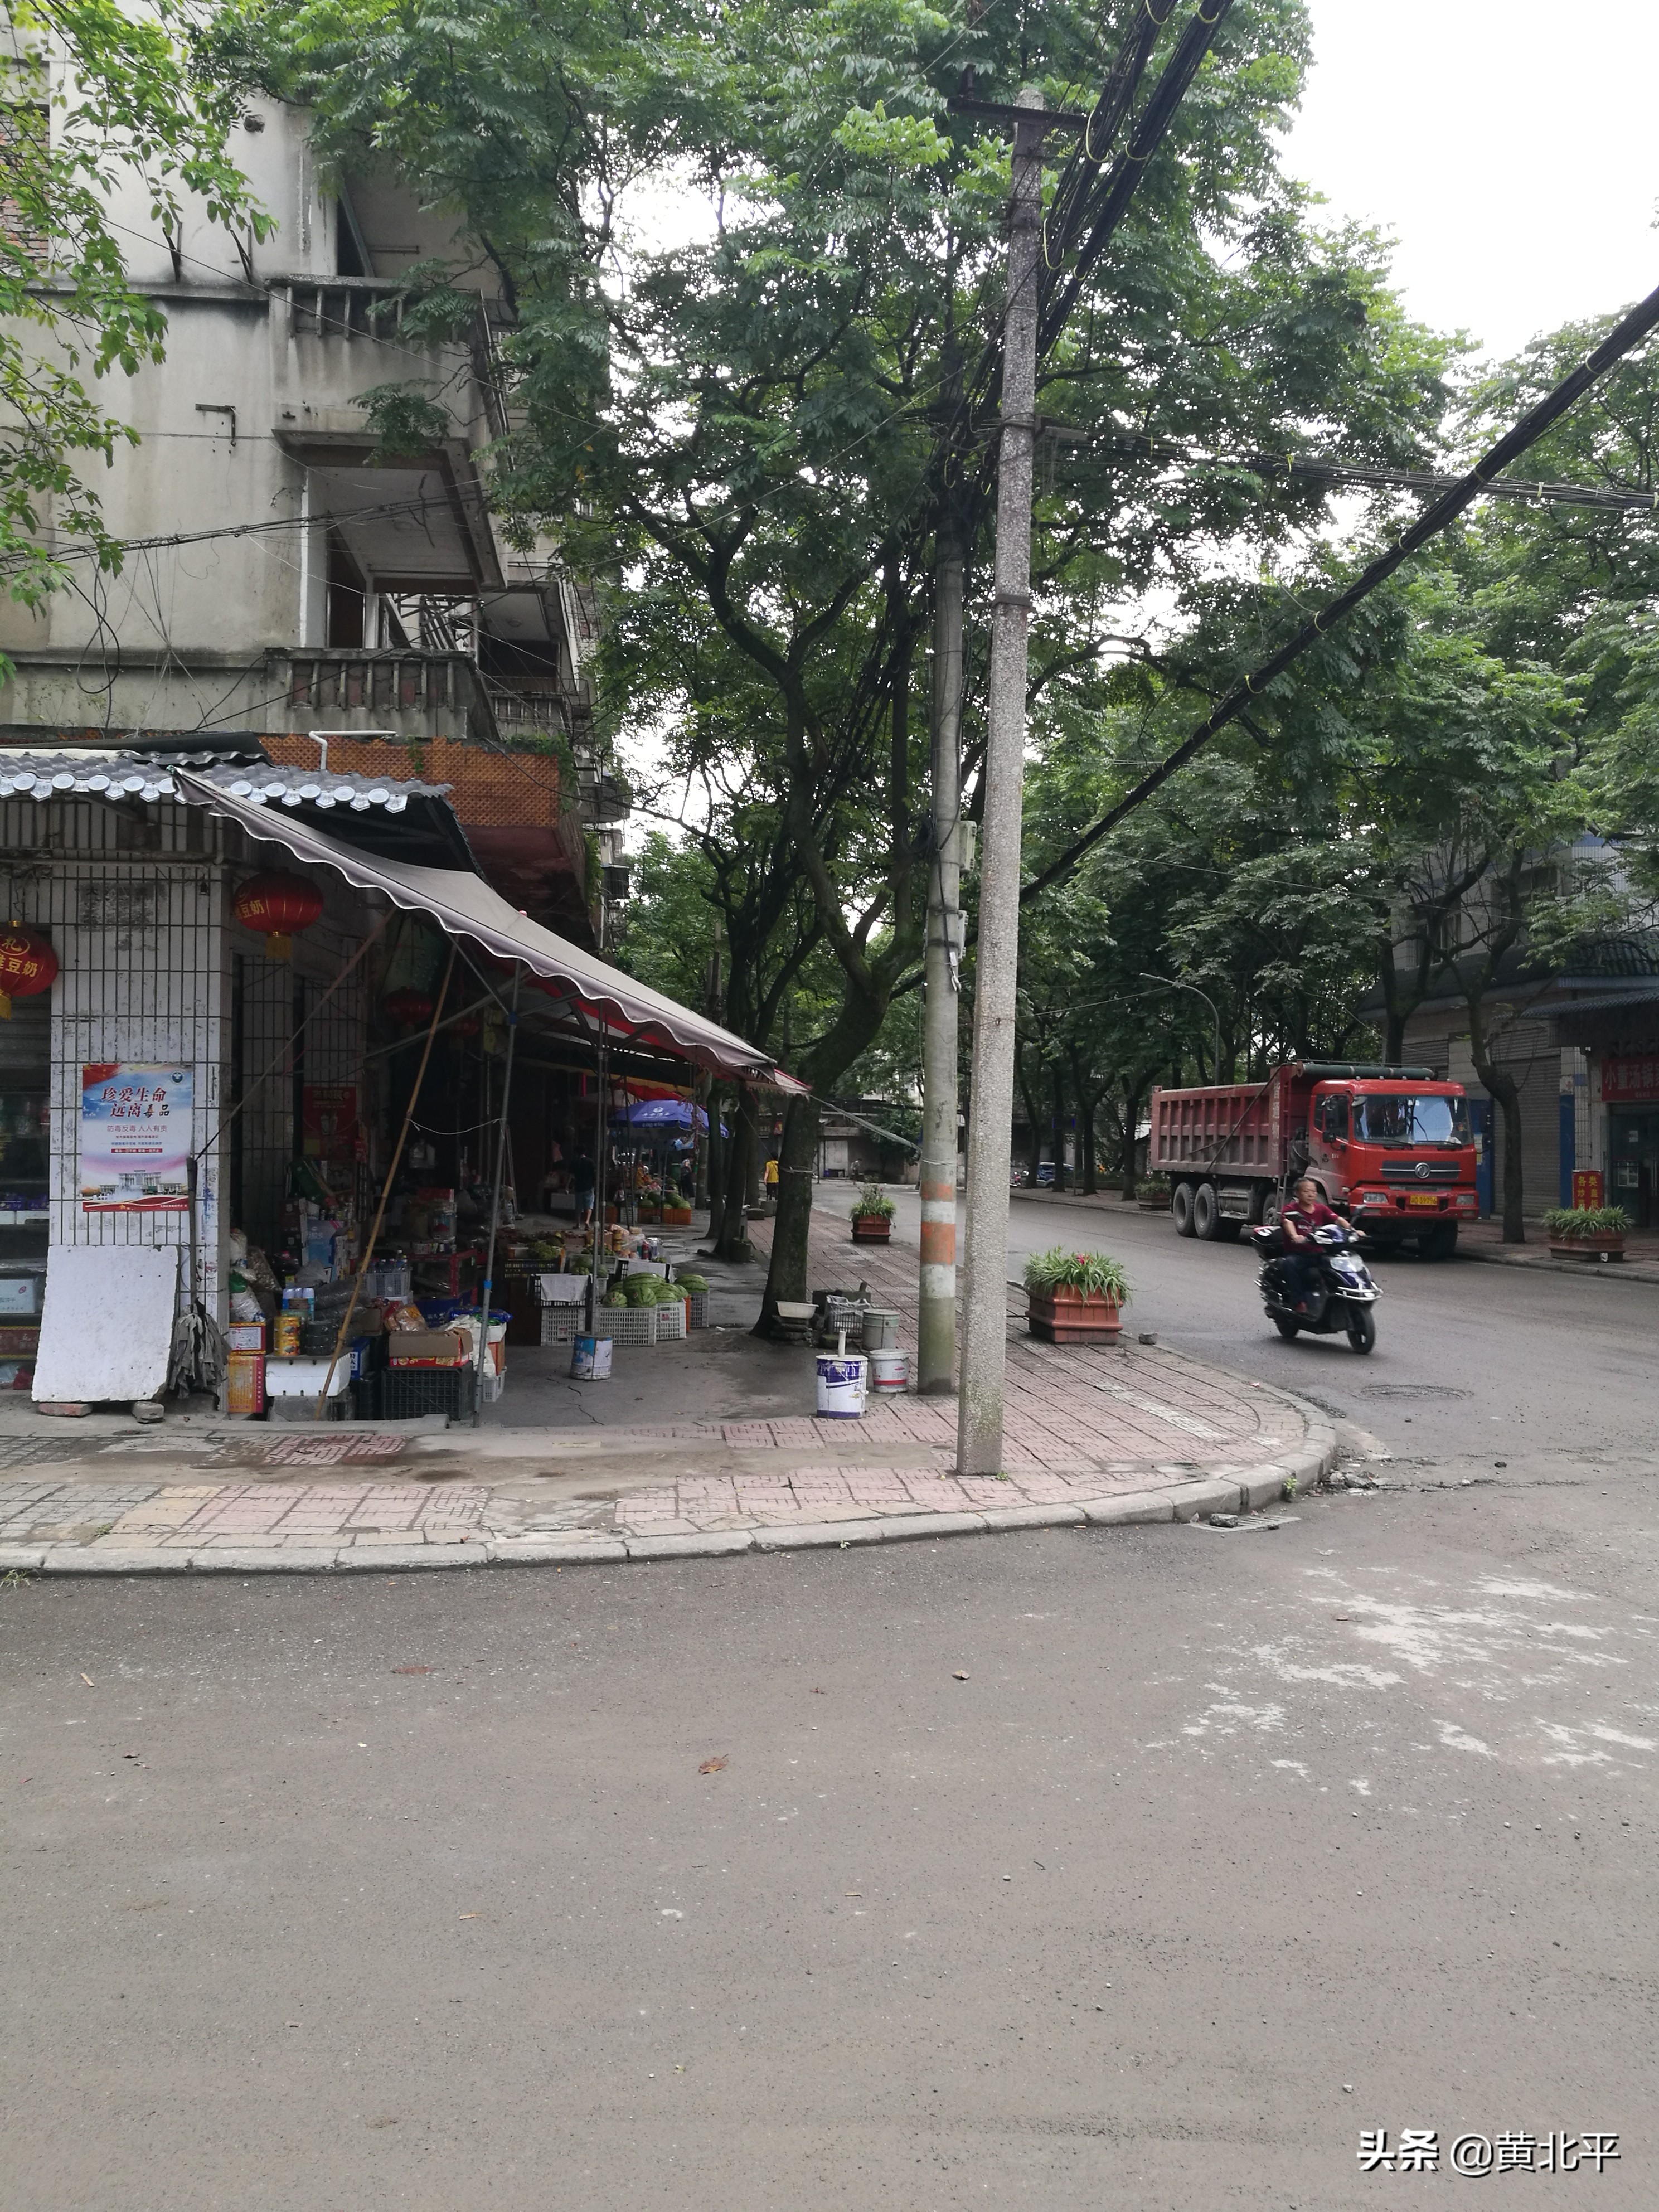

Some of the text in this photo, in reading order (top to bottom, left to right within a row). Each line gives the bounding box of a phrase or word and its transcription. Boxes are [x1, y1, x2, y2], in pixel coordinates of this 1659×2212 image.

[1605, 1063, 1659, 1090] 小董汤锅
[101, 1087, 167, 1102] 珍爱生命
[110, 1103, 170, 1118] 远离毒品
